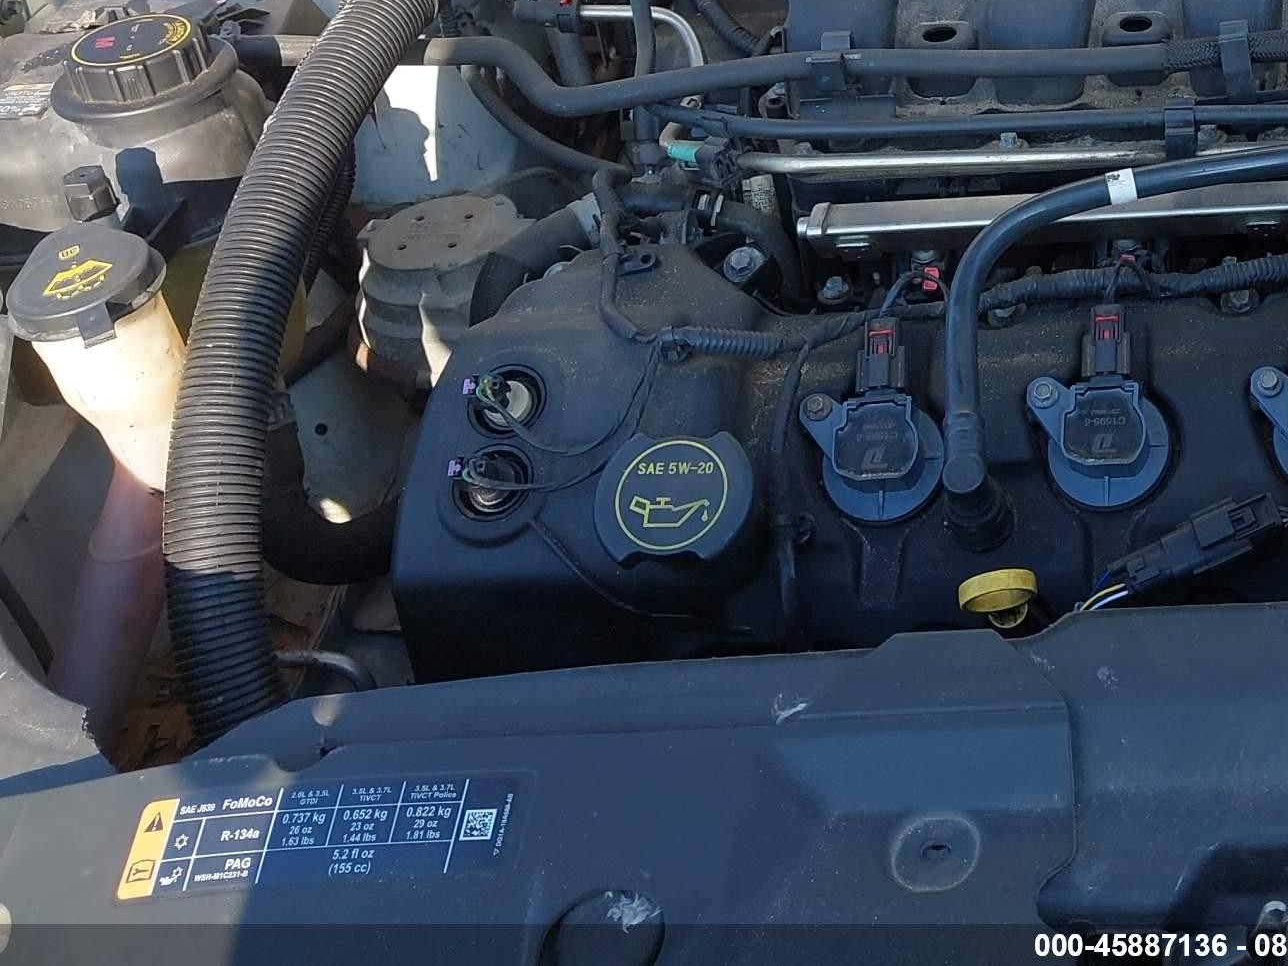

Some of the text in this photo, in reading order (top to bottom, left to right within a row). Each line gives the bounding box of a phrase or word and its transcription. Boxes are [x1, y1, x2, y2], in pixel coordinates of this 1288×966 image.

[637, 461, 714, 475] SAE 5W-20
[433, 791, 458, 799] Police
[222, 795, 273, 811] FoMoCo
[180, 805, 197, 815] SAE
[343, 809, 389, 822] 0.652 kg
[406, 806, 452, 819] 0.822 kg
[282, 813, 326, 825] 0.737 kg
[413, 819, 438, 828] 29 oz
[289, 826, 299, 835] 26
[350, 823, 361, 832] 23
[220, 829, 261, 843] R-134a
[342, 833, 377, 843] 1.44 lbs
[406, 830, 440, 840] 1.81 lbs
[281, 836, 315, 847] 1.63 lbs
[332, 848, 376, 861] 5.2 fl oz
[224, 857, 251, 870] PAG
[328, 862, 372, 876] (155 cc)
